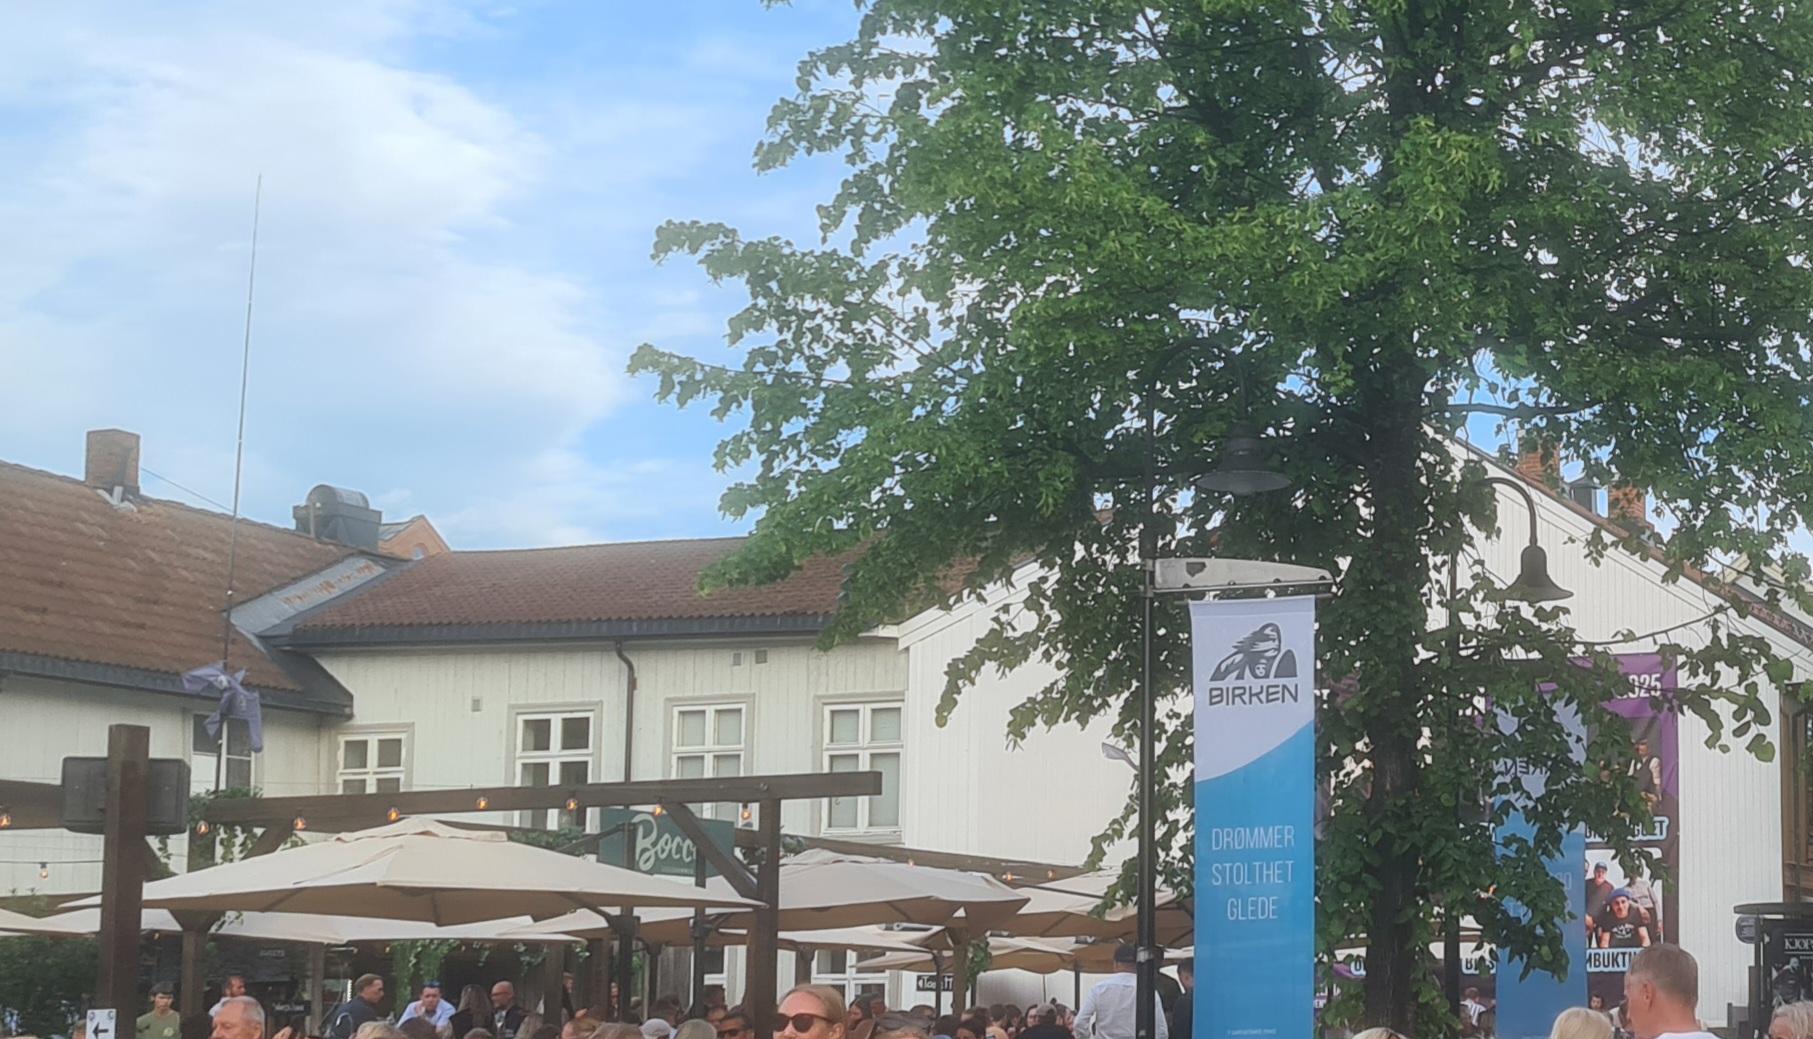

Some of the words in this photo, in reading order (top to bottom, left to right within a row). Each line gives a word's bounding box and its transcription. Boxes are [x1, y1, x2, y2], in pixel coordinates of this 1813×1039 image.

[1208, 683, 1298, 706] BIRKEN
[1611, 674, 1661, 699] 025
[631, 813, 697, 871] Bocc
[1212, 825, 1295, 850] DRØMMER
[1212, 860, 1294, 886] STOLTHET
[1227, 896, 1279, 921] GLEDE
